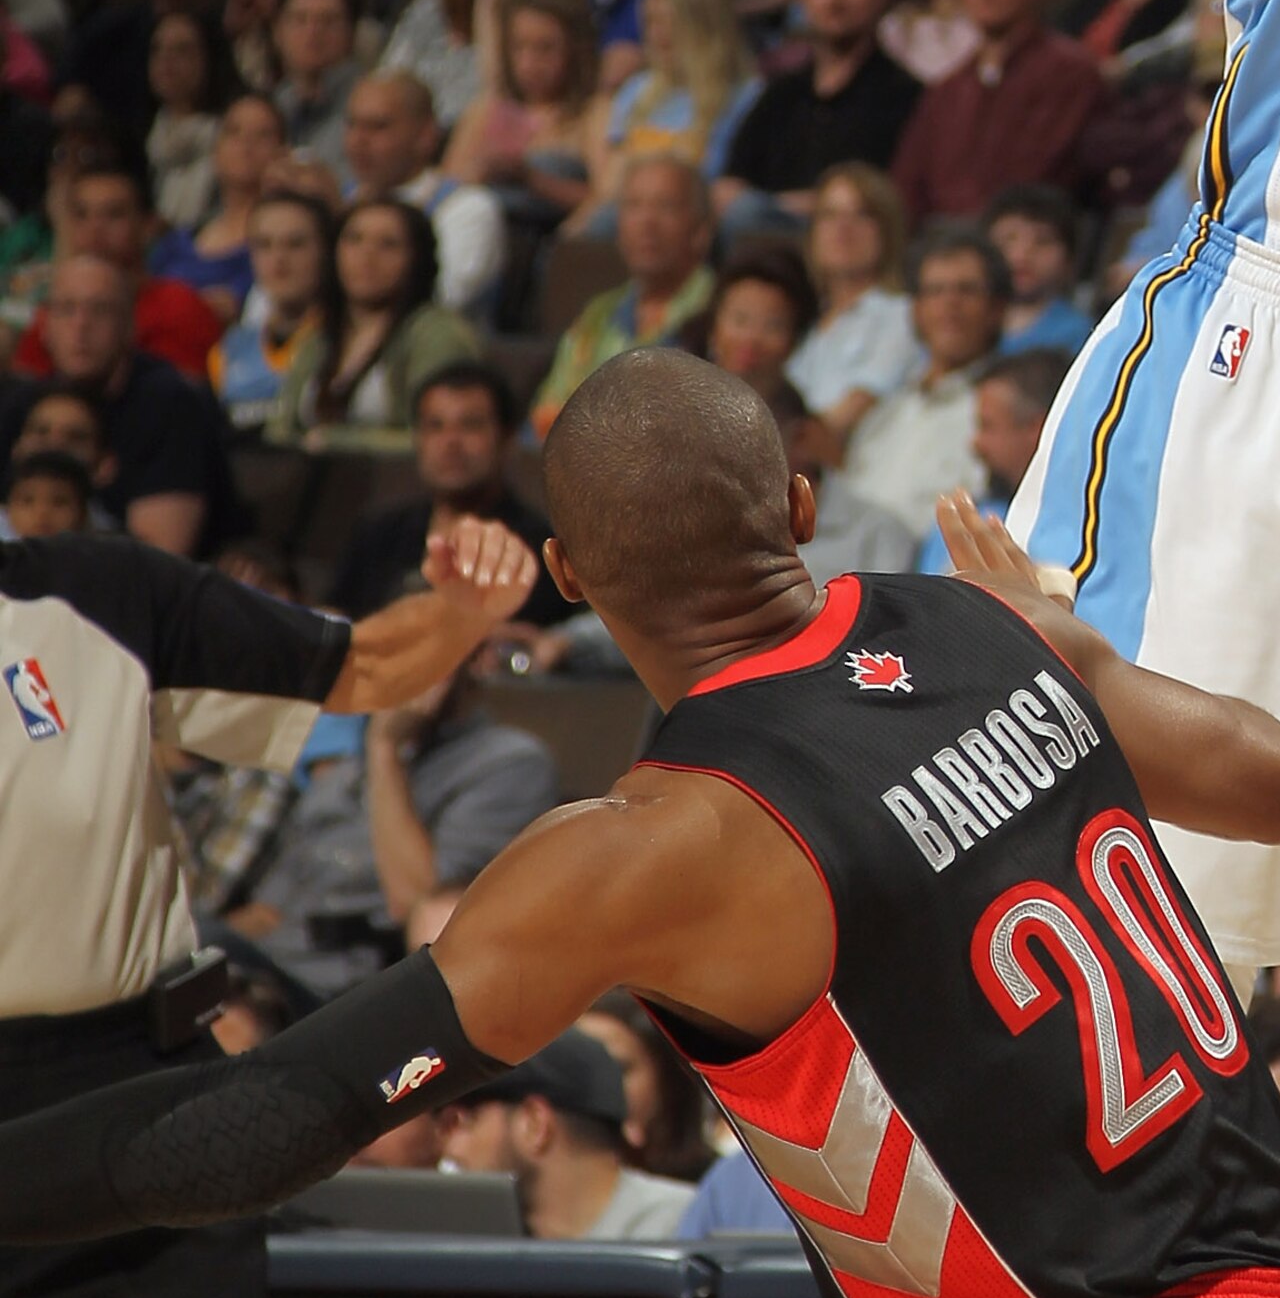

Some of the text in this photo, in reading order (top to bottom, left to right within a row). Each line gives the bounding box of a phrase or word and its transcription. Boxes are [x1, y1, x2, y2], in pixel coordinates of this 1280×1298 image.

[28, 721, 56, 739] NBA
[880, 669, 1101, 874] BARBOSA
[969, 807, 1251, 1175] 20
